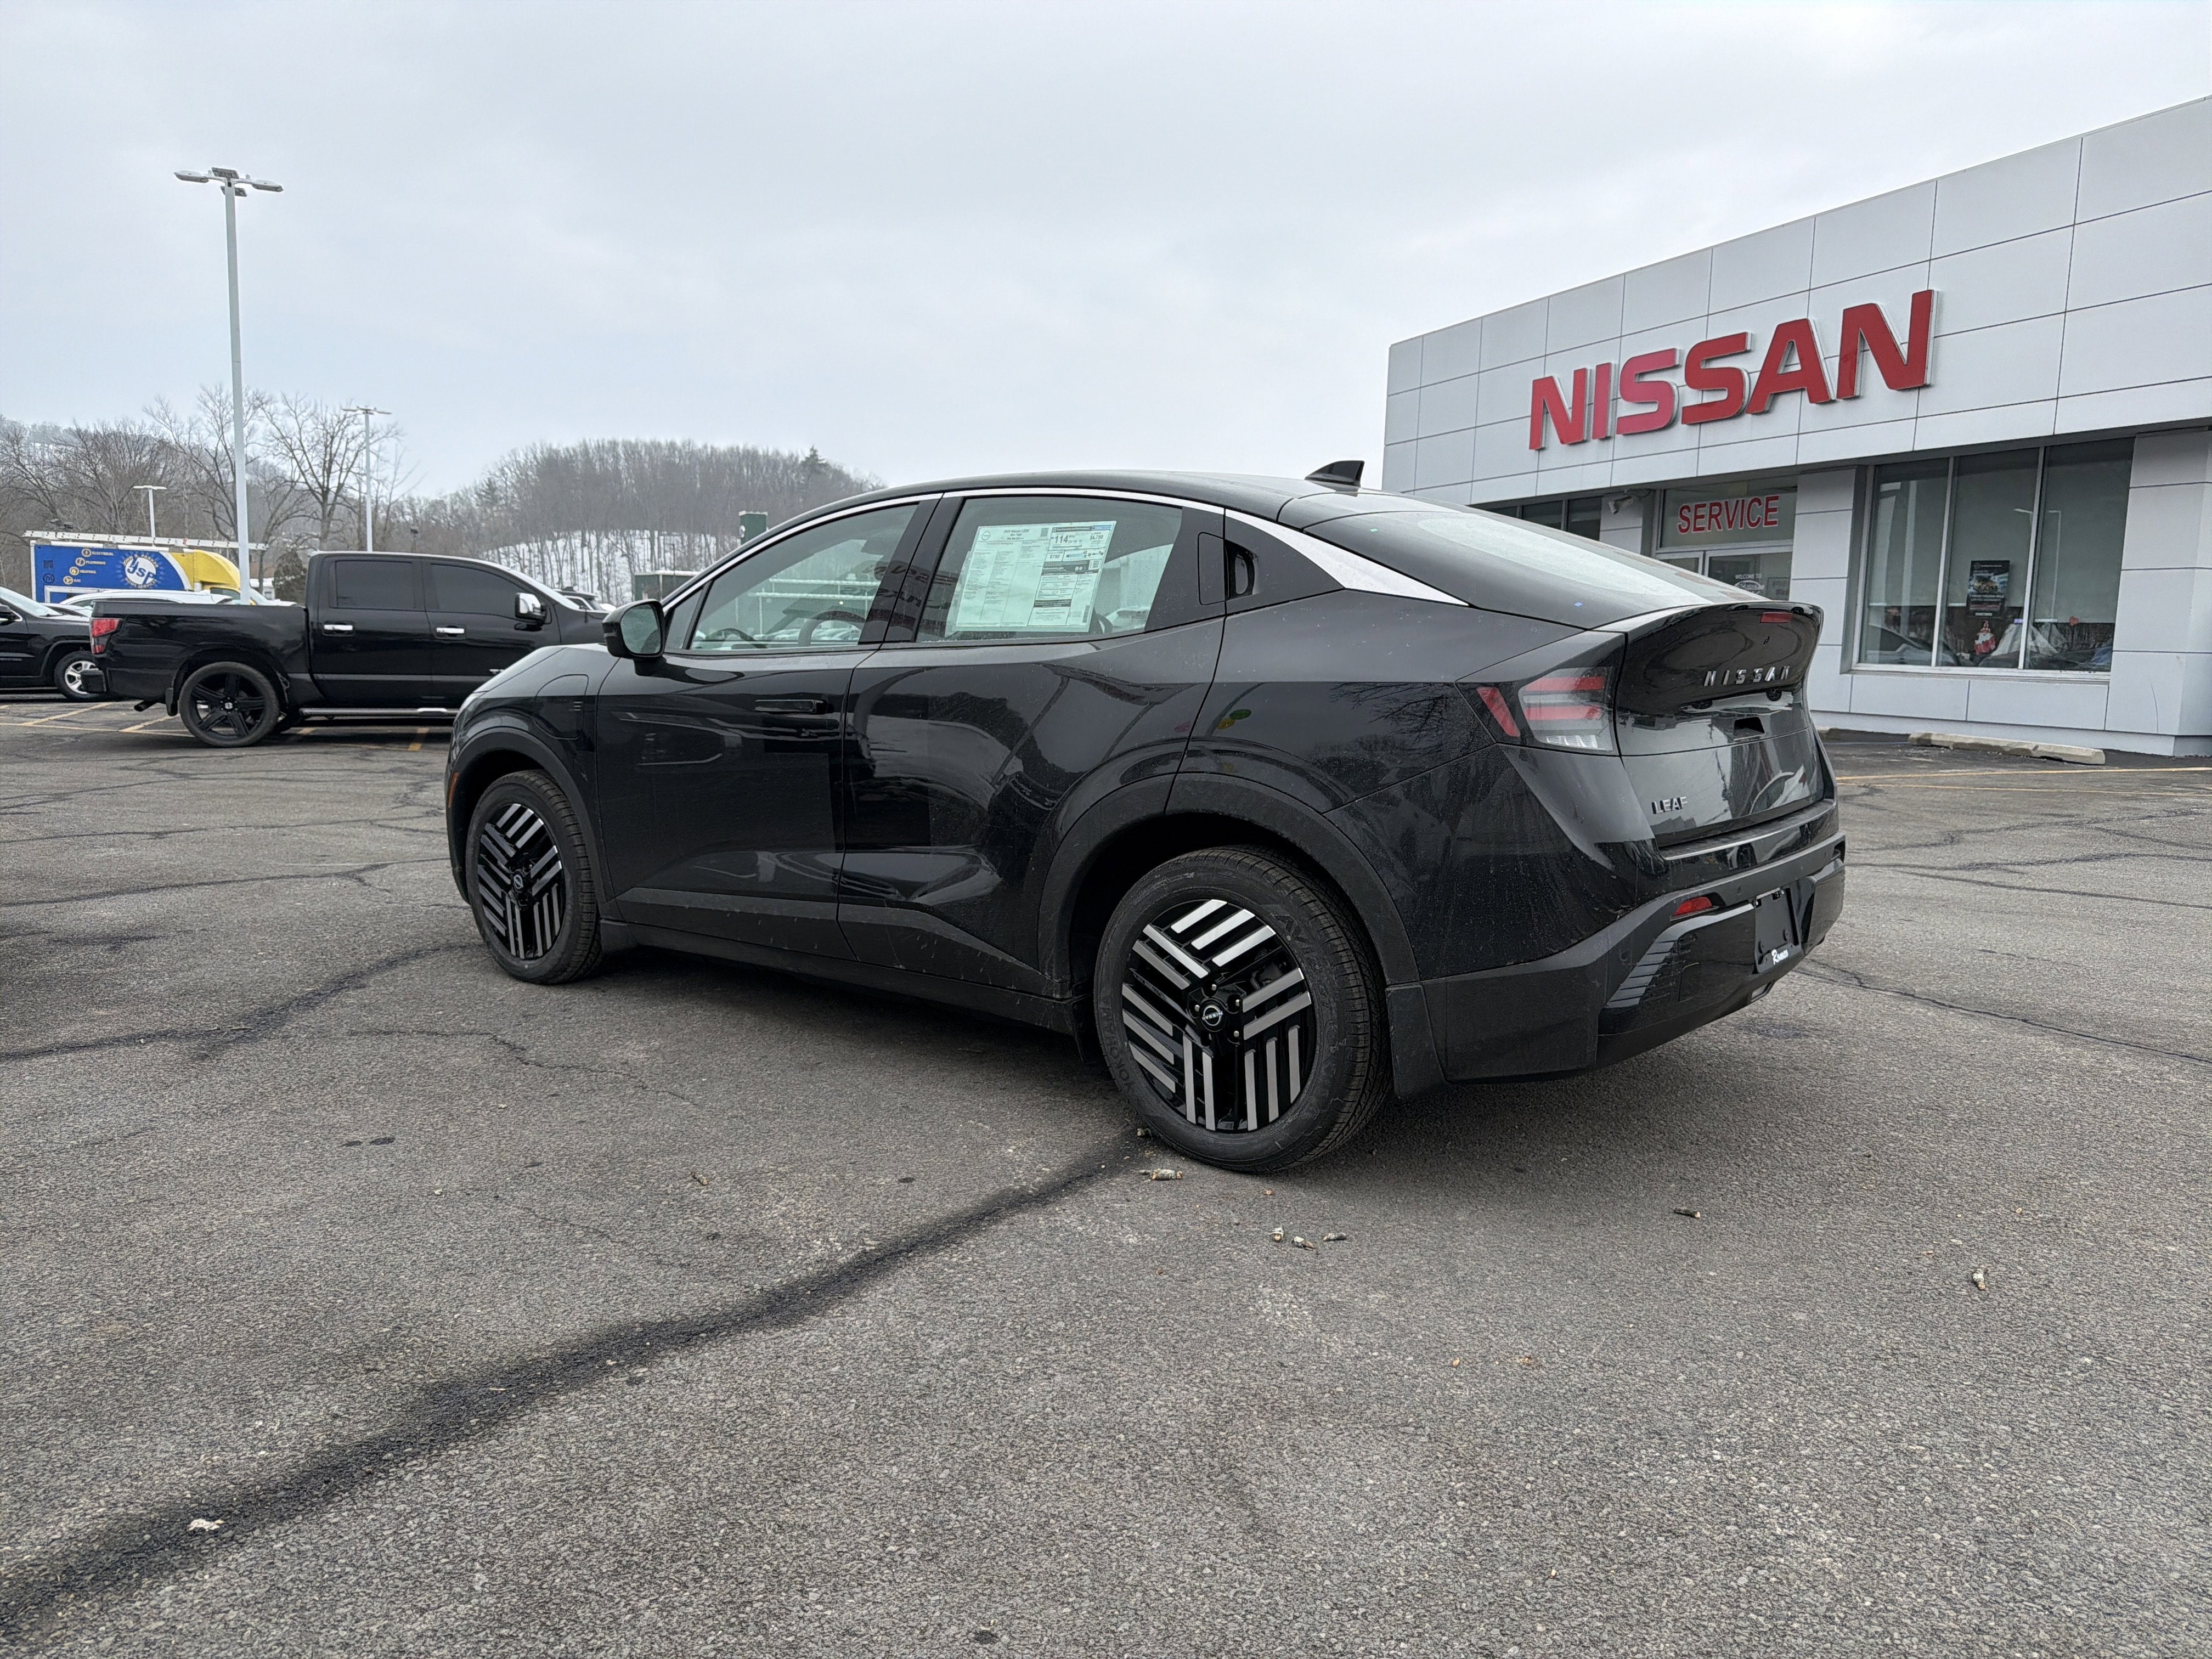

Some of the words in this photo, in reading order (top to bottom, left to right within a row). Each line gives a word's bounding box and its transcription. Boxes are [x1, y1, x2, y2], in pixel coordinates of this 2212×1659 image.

[1528, 289, 1938, 450] NISSAN
[1677, 495, 1780, 534] SERVICE
[1054, 534, 1069, 544] 114
[1703, 665, 1790, 686] NISSAN
[1651, 796, 1688, 814] LEAF
[1201, 1011, 1223, 1021] NISSAN
